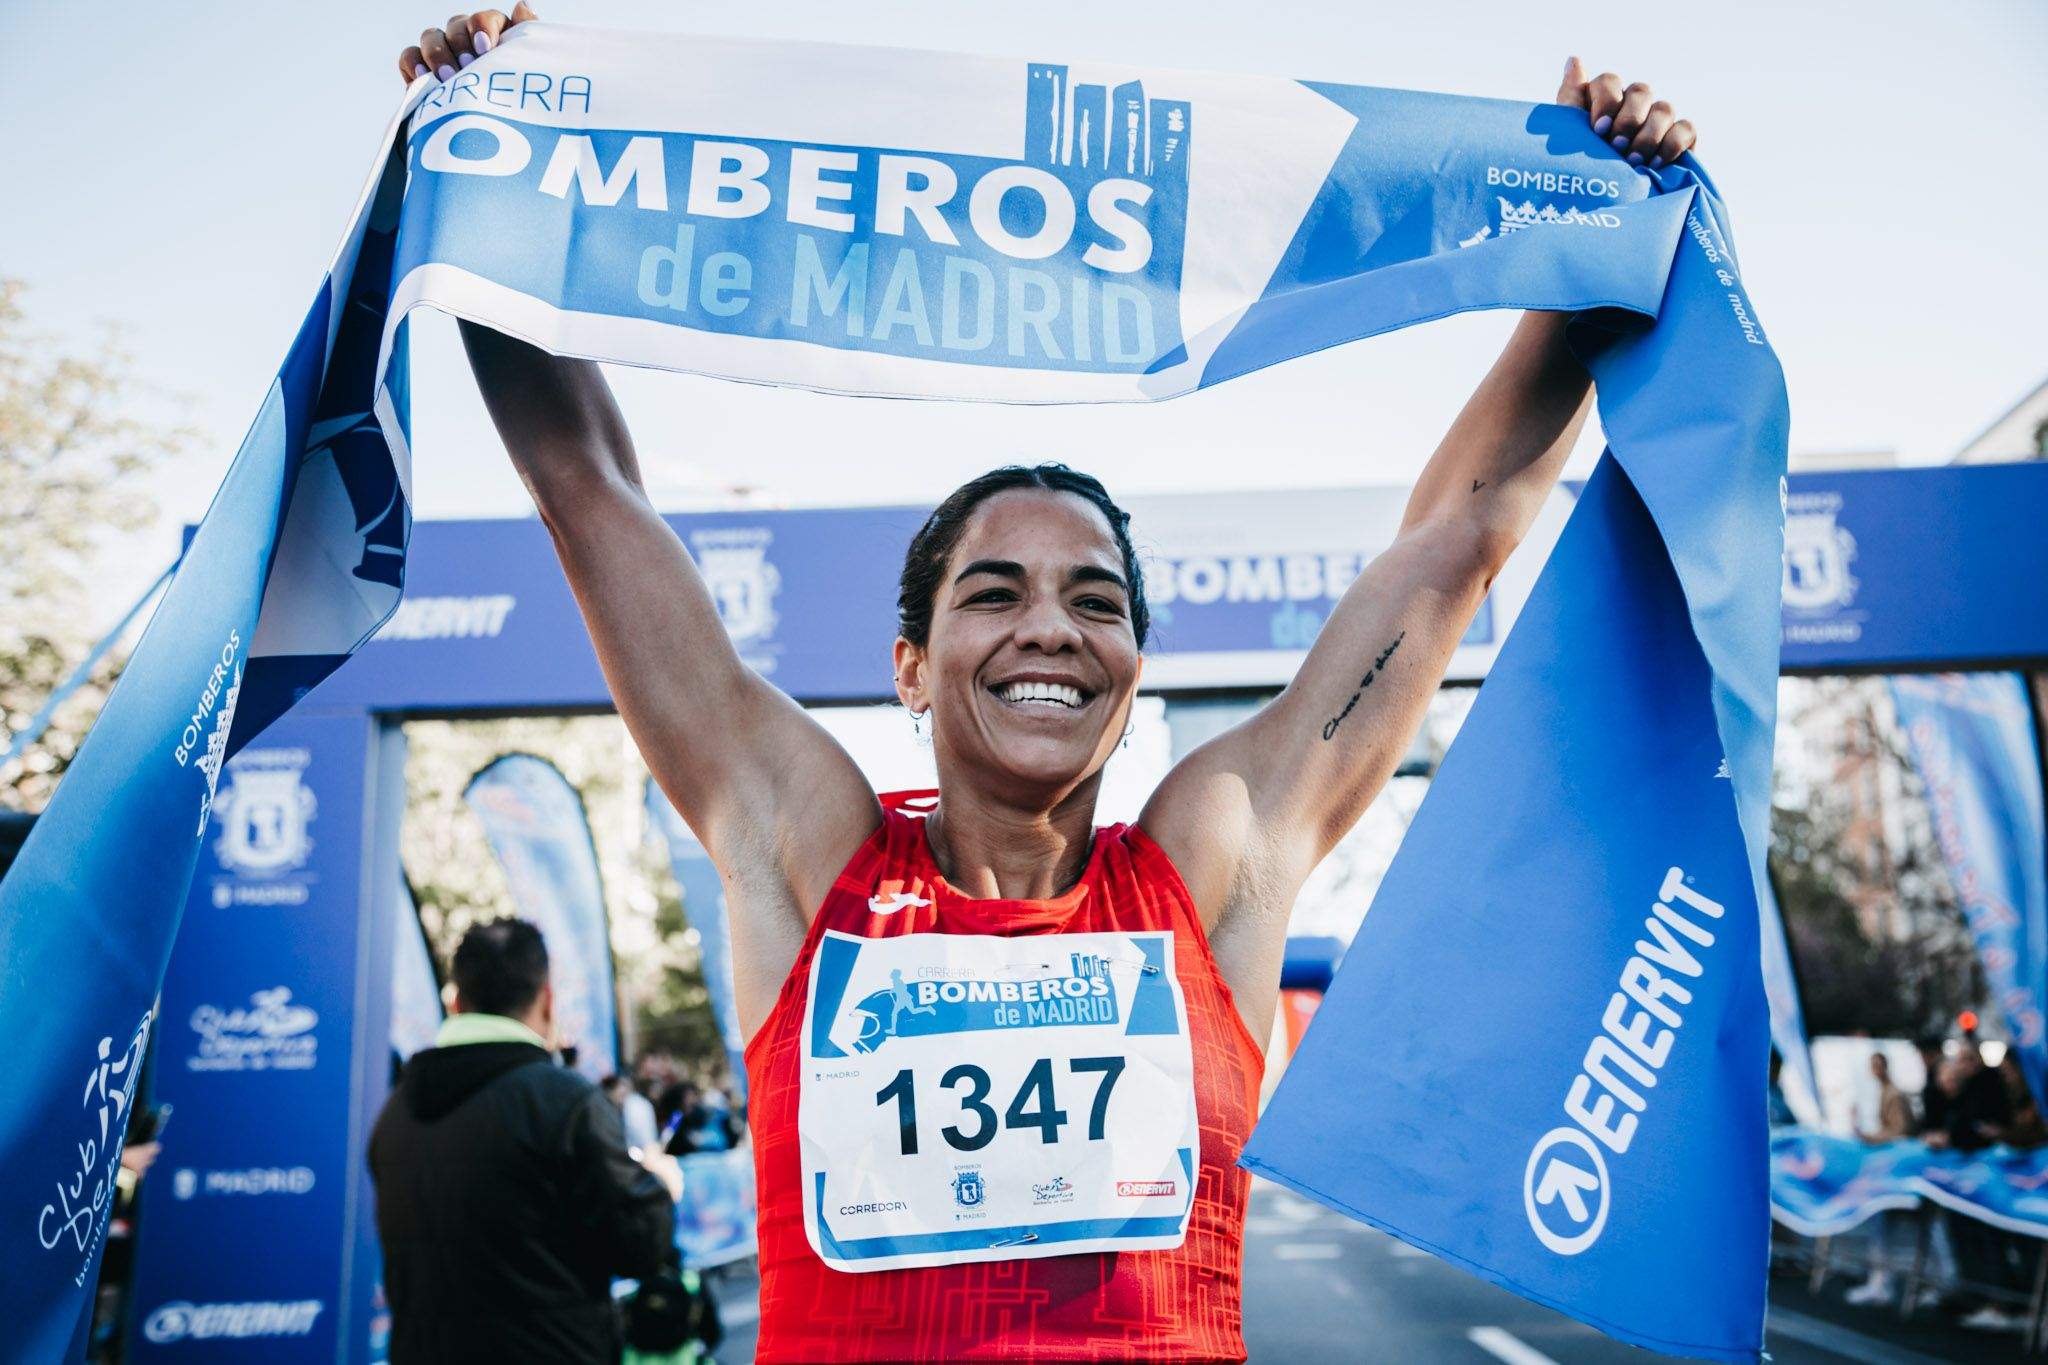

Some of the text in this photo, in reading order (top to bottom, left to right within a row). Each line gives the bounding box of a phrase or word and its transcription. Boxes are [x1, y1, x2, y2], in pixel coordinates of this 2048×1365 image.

[410, 72, 592, 126] RRERA
[403, 114, 1154, 273] OMBEROS
[1487, 166, 1620, 198] BOMBEROS
[637, 223, 1157, 365] de MADRID
[1716, 268, 1734, 287] de
[1728, 293, 1764, 345] madrid
[1146, 556, 1372, 604] BOMBE
[175, 629, 240, 767] BOMBEROS
[917, 966, 976, 978] CARRERA
[918, 977, 1109, 1005] BOMBEROS
[994, 997, 1113, 1026] de MADRID
[1564, 866, 1725, 1154] ENERVIT
[826, 1070, 860, 1081] MADRID
[876, 1056, 1125, 1155] 1347
[39, 1138, 96, 1249] Club
